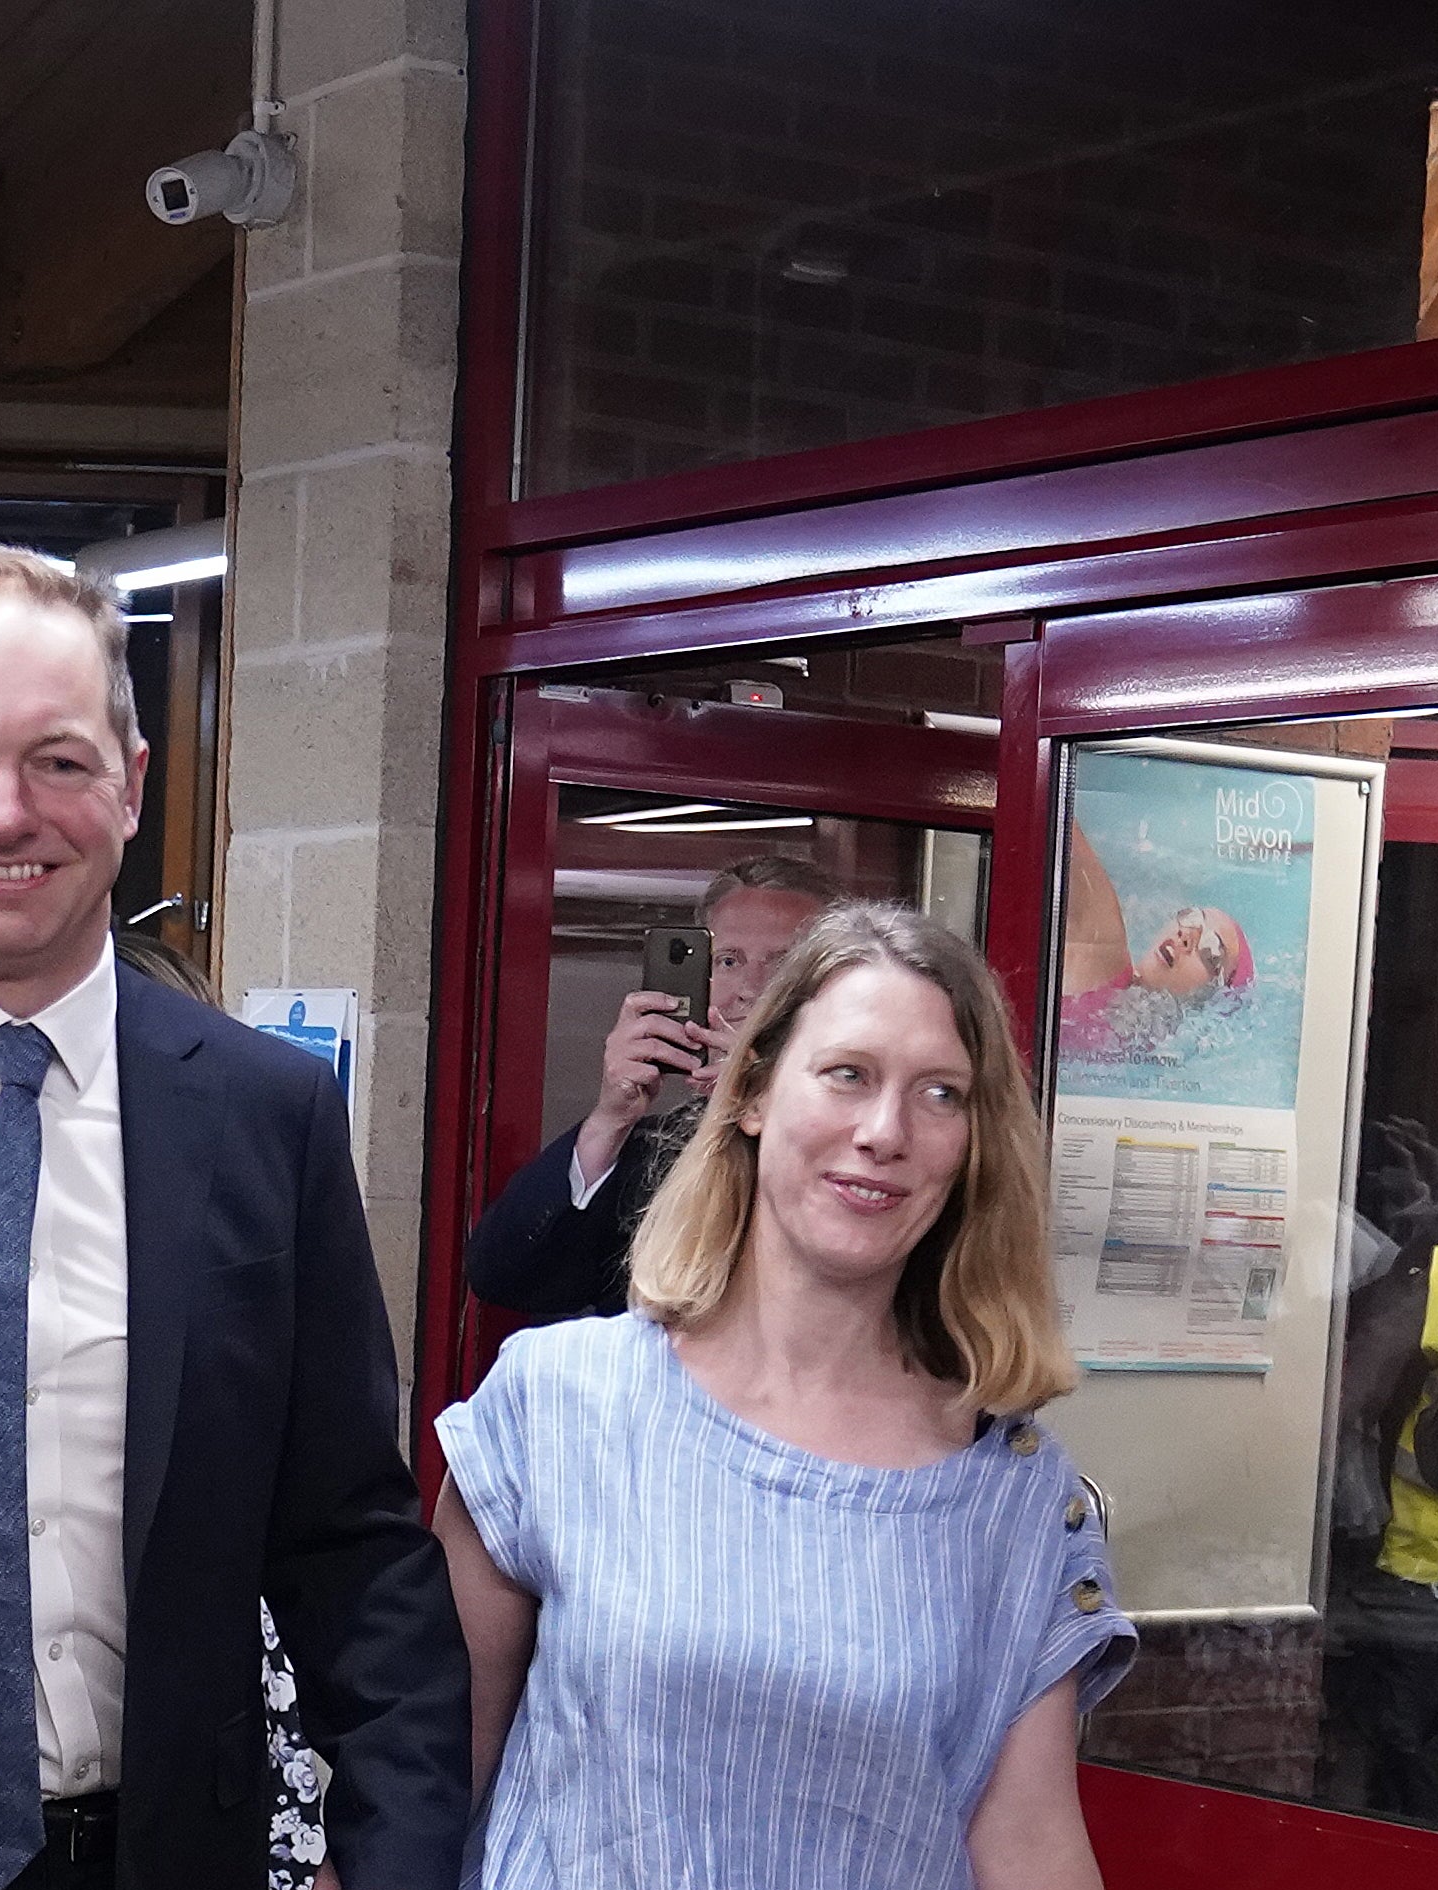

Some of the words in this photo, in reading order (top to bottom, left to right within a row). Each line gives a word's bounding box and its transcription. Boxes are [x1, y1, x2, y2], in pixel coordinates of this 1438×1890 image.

[1216, 788, 1260, 818] Mid
[1216, 815, 1292, 850] Devon
[1217, 844, 1292, 866] LEISURE
[1124, 1116, 1177, 1134] Discounting
